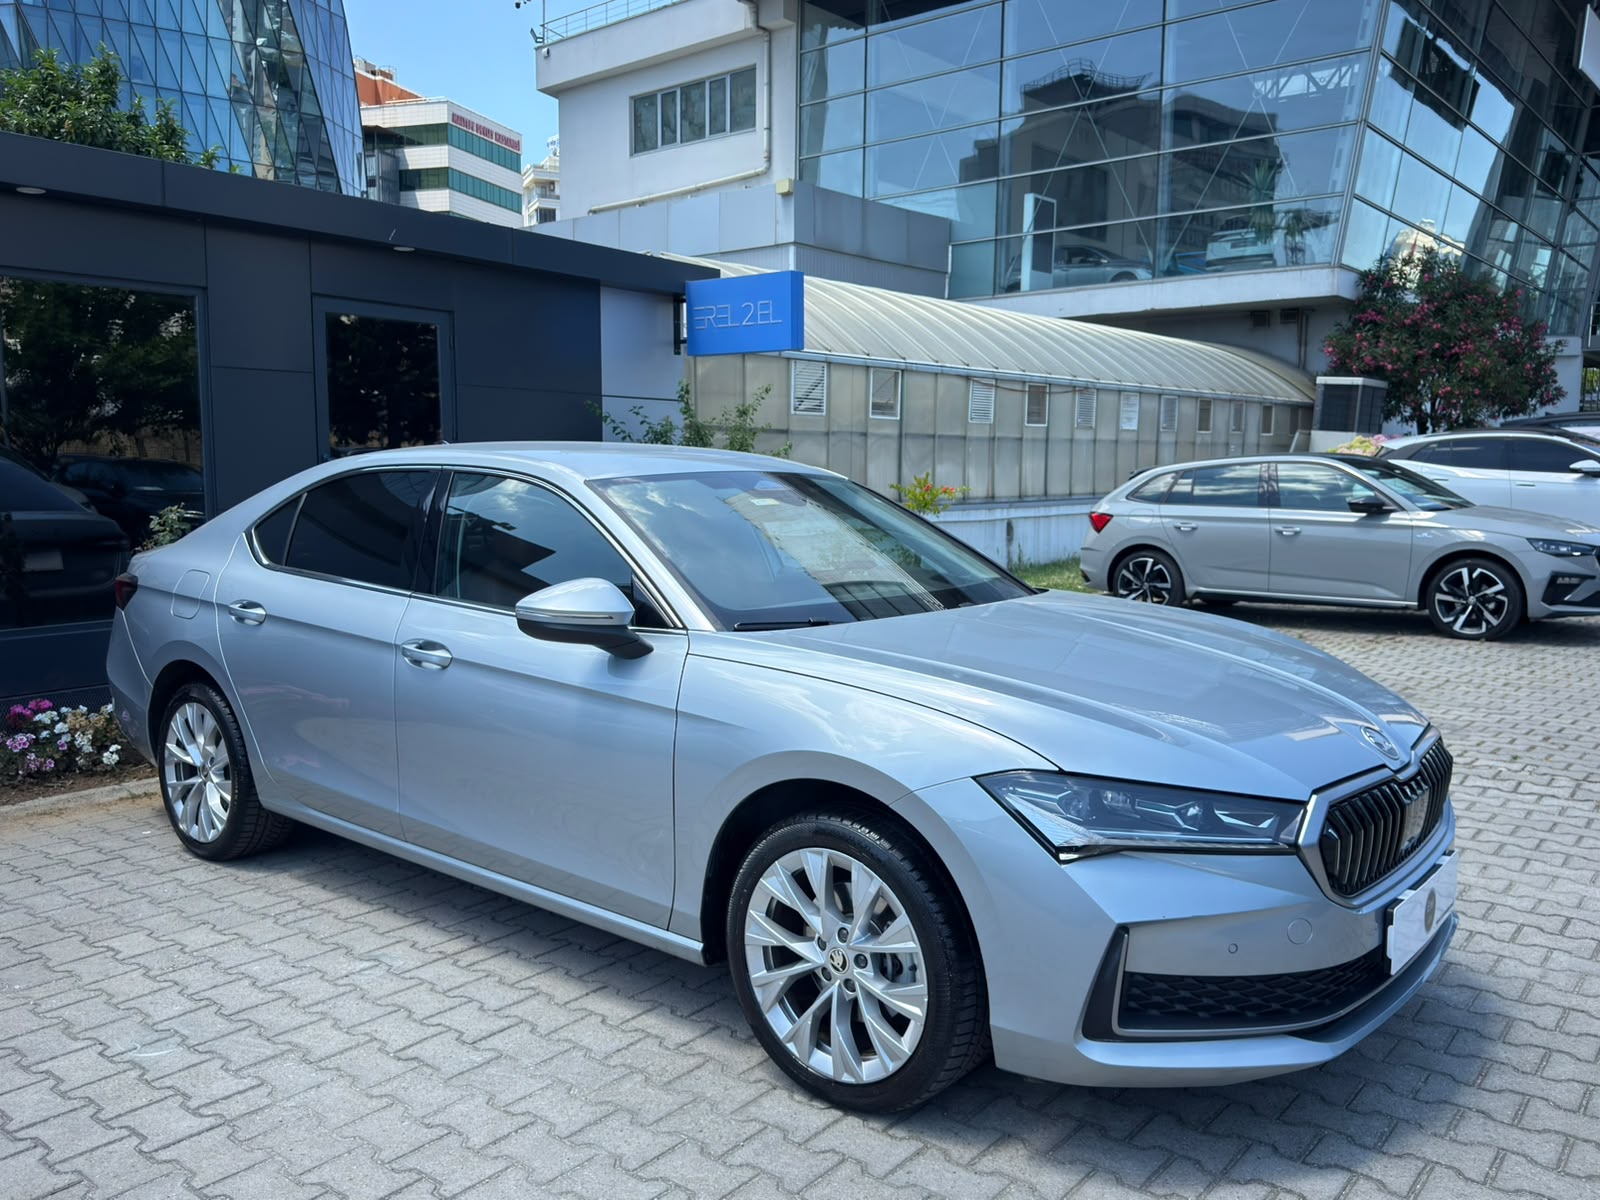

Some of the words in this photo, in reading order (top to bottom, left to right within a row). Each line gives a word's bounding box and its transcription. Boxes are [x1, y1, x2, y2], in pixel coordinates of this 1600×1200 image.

[693, 304, 740, 330] EREL
[742, 302, 755, 326] 2
[757, 300, 783, 324] EL
